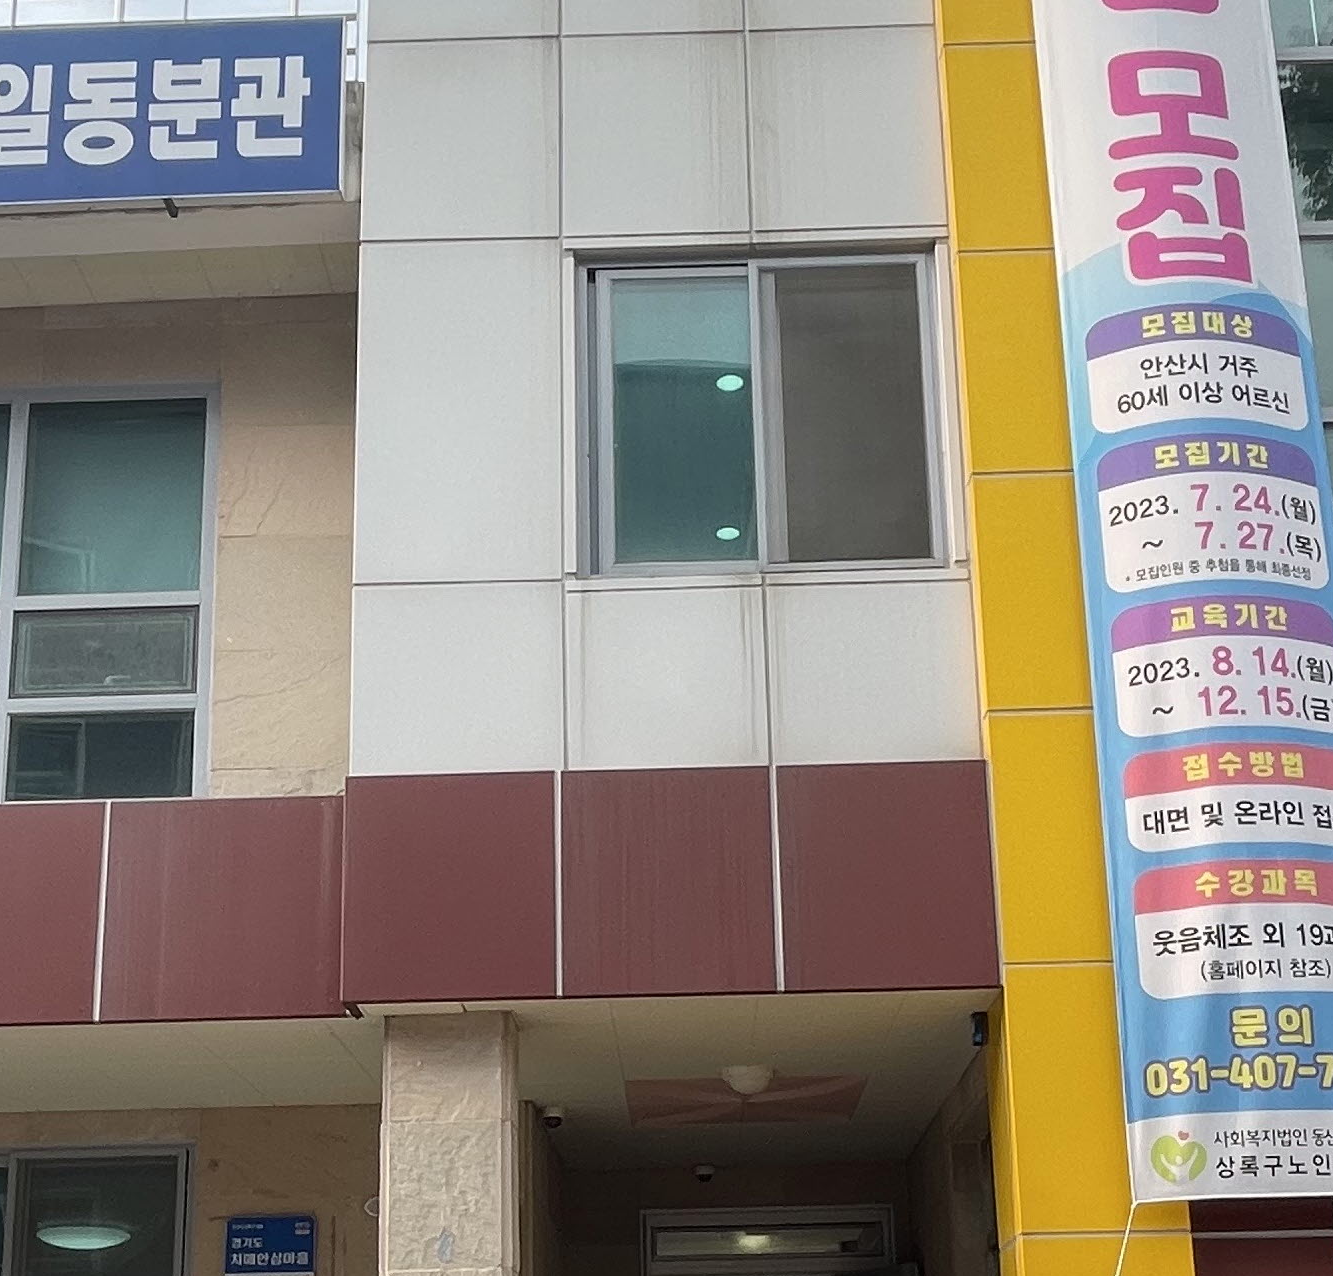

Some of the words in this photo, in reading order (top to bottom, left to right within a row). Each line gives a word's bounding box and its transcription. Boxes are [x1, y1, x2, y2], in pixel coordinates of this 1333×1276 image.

[1107, 50, 1252, 284] 모집
[1142, 311, 1253, 338] 모집대상
[1140, 353, 1208, 379] 안산시
[1219, 355, 1259, 378] 거주
[1117, 385, 1168, 414] 60세
[1178, 382, 1223, 403] 이상
[1232, 384, 1290, 414] 어르신
[1154, 441, 1268, 469] 모집기간
[1109, 495, 1179, 526] 2023.
[1190, 484, 1221, 511] 7.
[1194, 522, 1226, 549] 7.
[1136, 561, 1184, 582] 모집인원
[1188, 559, 1200, 574] 중
[1271, 561, 1311, 580] 최종선정
[1171, 603, 1288, 632] 교육기간
[1128, 657, 1200, 687] 2023.
[1212, 646, 1242, 676] 8.
[1198, 685, 1246, 716] 12.
[1182, 751, 1304, 782] 접수방법
[1143, 807, 1190, 834] 대면
[1201, 802, 1224, 828] 및
[1234, 801, 1305, 826] 온라인
[1195, 868, 1318, 898] 수강과목
[1153, 923, 1252, 956] 웃음체조
[1263, 922, 1285, 948] 외
[1201, 958, 1282, 982] (홈페이지
[1290, 958, 1332, 979] 참조)
[1231, 1004, 1315, 1047] 문의
[1214, 1129, 1308, 1147] 사회복지법인
